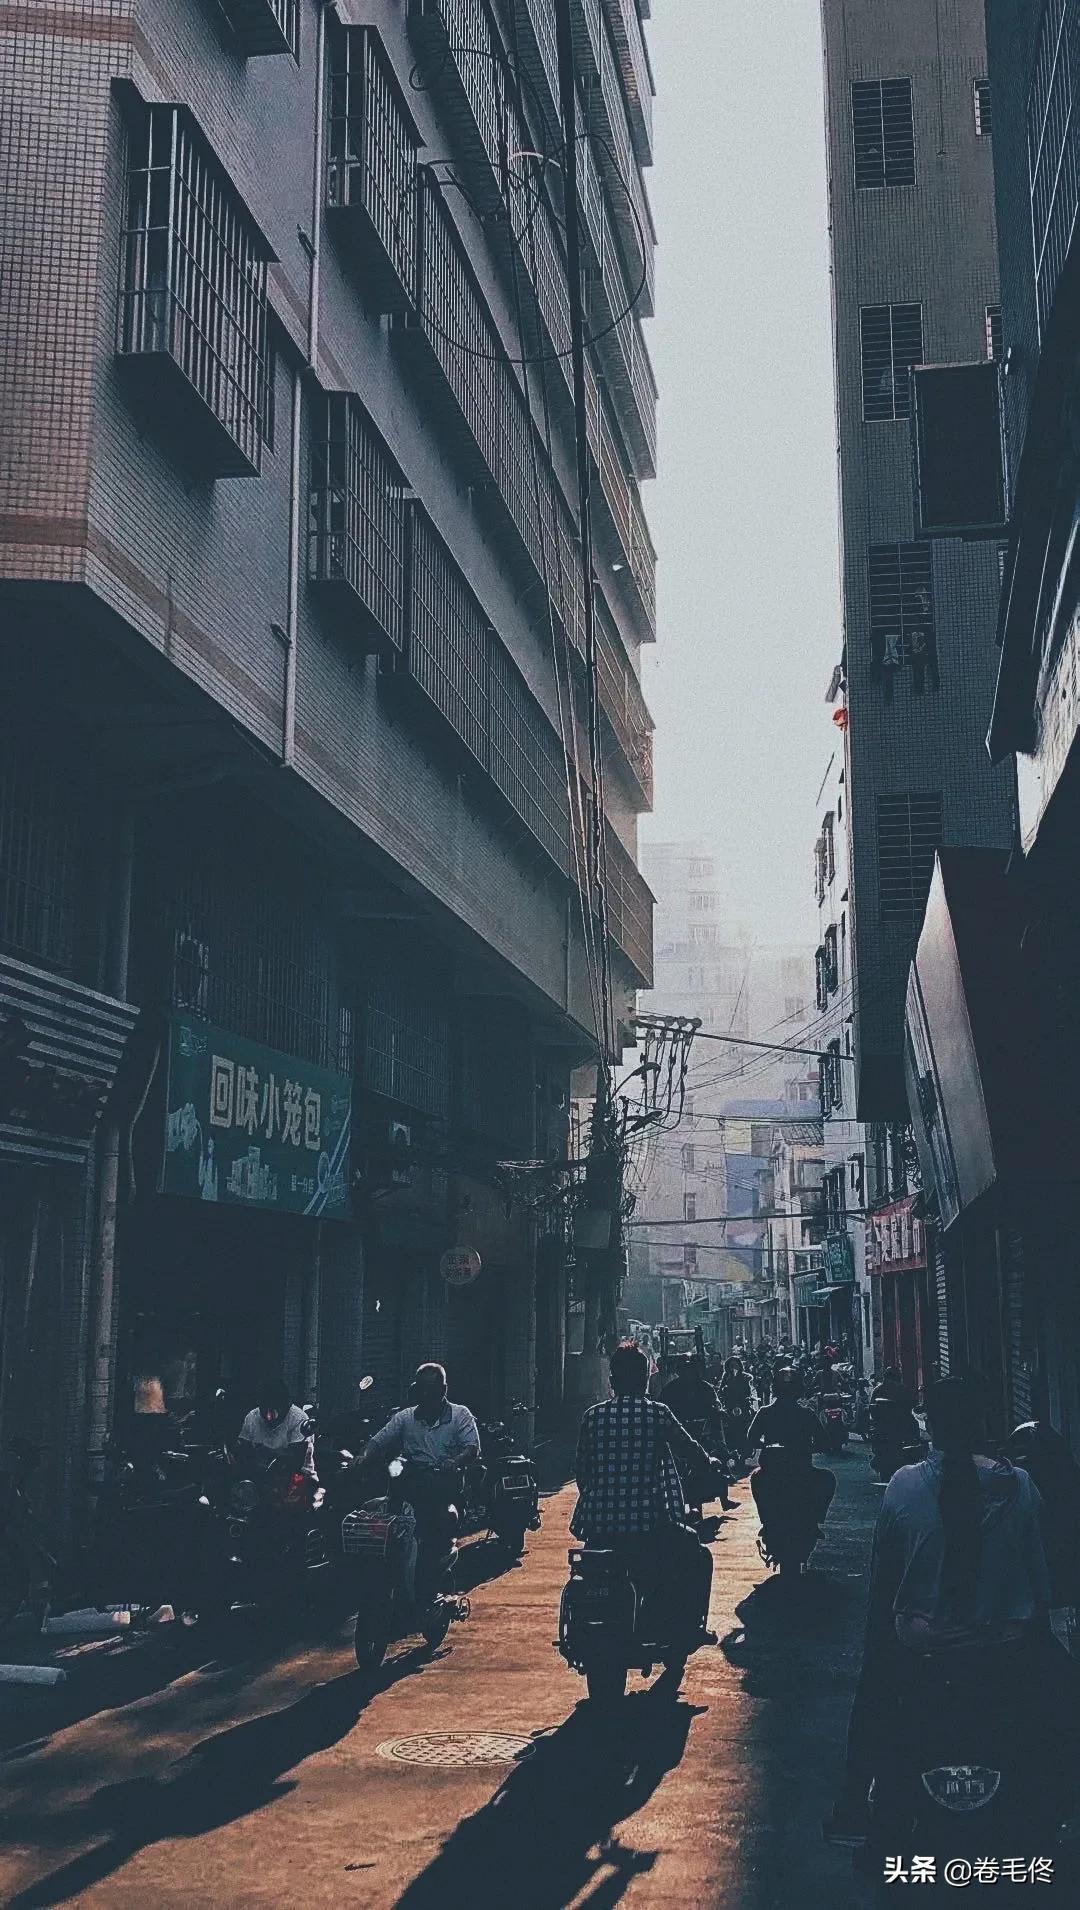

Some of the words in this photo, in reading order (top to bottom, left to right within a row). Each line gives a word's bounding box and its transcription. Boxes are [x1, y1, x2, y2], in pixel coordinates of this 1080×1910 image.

[209, 1054, 321, 1151] 回味小笼包
